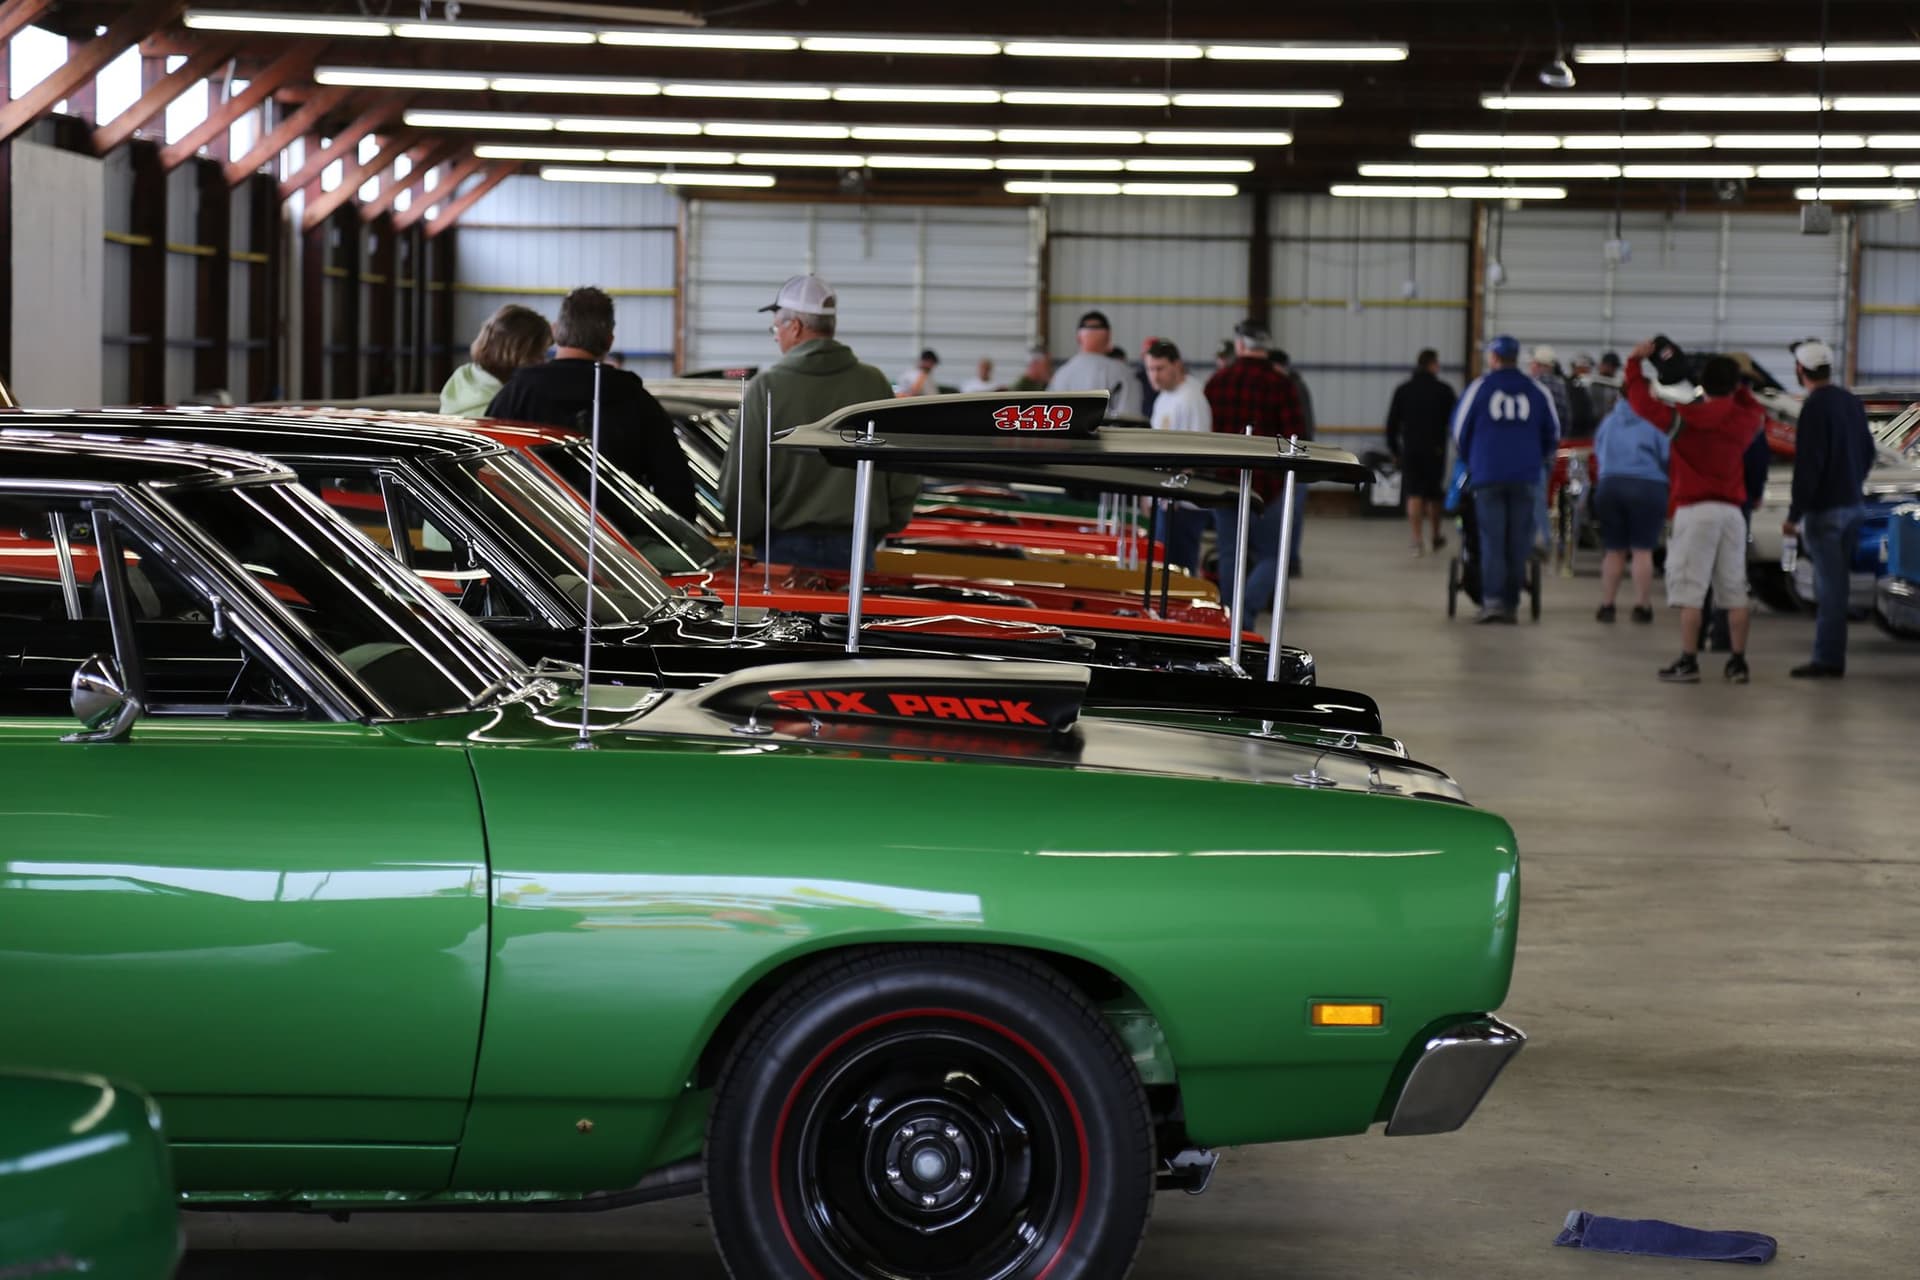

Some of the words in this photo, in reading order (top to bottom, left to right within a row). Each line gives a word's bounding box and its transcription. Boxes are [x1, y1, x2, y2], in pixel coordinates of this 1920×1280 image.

[992, 405, 1073, 425] 440
[768, 690, 878, 714] SIX
[888, 694, 1048, 726] PACK
